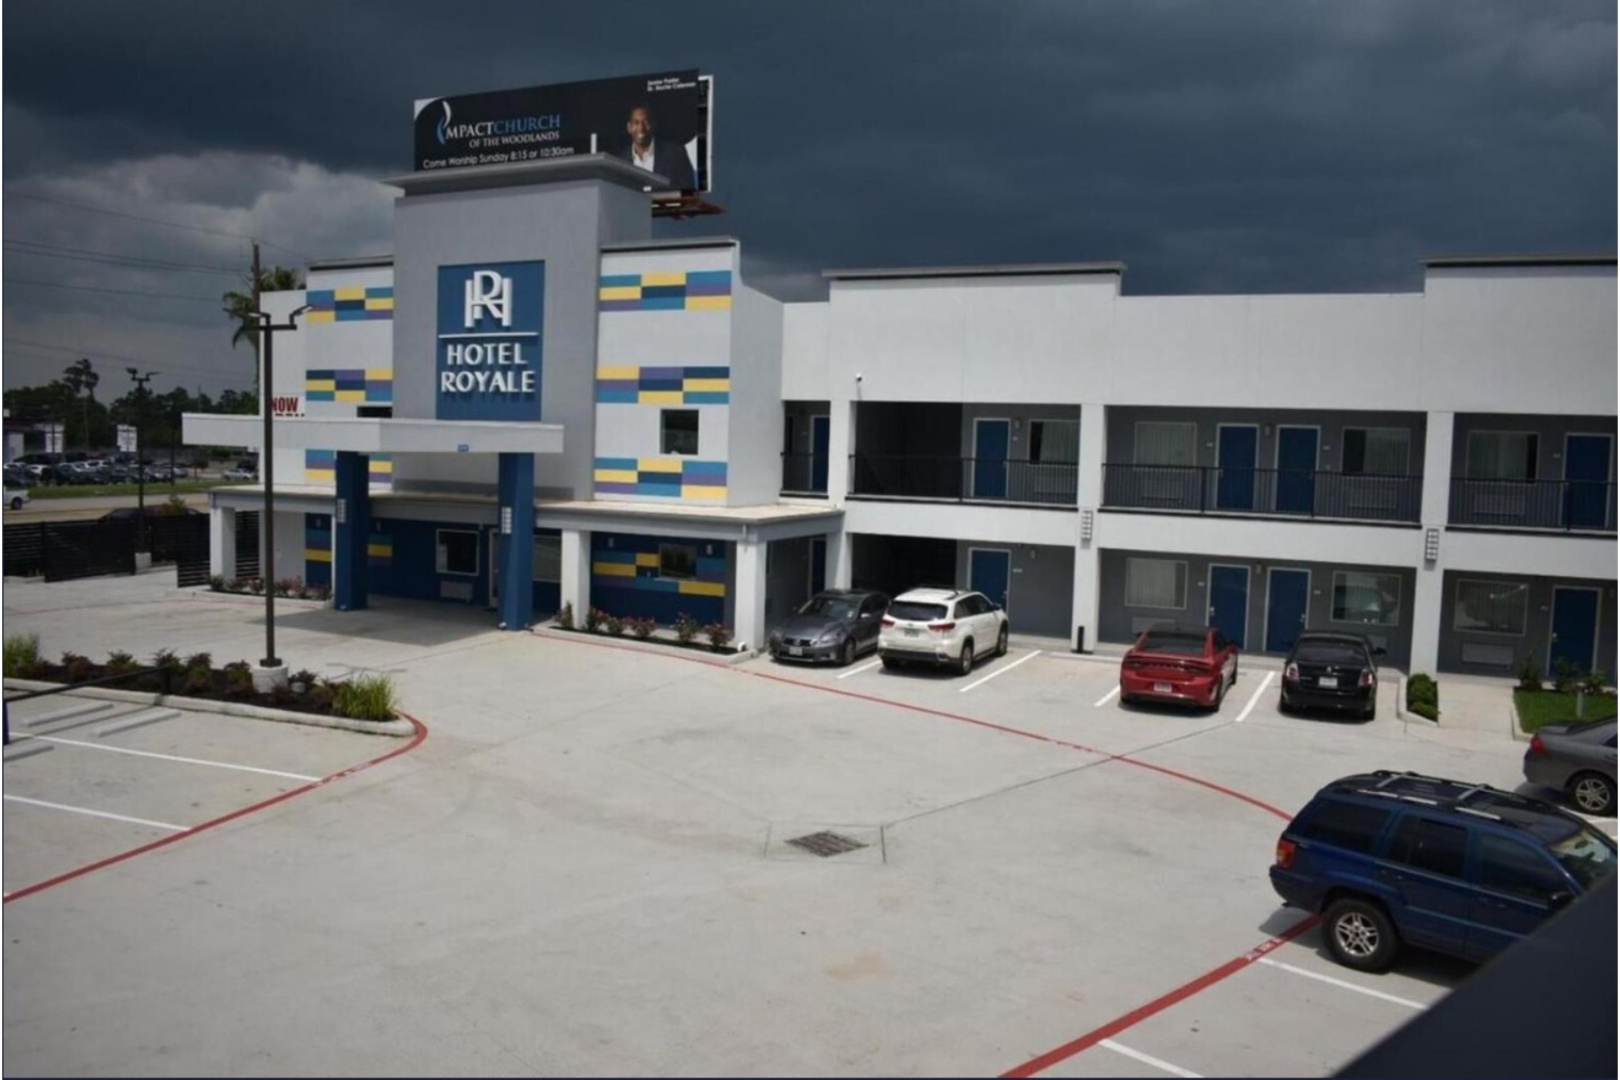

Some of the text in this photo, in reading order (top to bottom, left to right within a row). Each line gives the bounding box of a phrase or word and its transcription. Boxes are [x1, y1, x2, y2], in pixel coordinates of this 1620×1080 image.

[469, 130, 560, 149] OF THE WOODLANDS
[422, 146, 574, 170] Come Worship Sunday 8:15 or 10:30am
[446, 342, 529, 366] HOTEL
[440, 370, 537, 393] ROYALE
